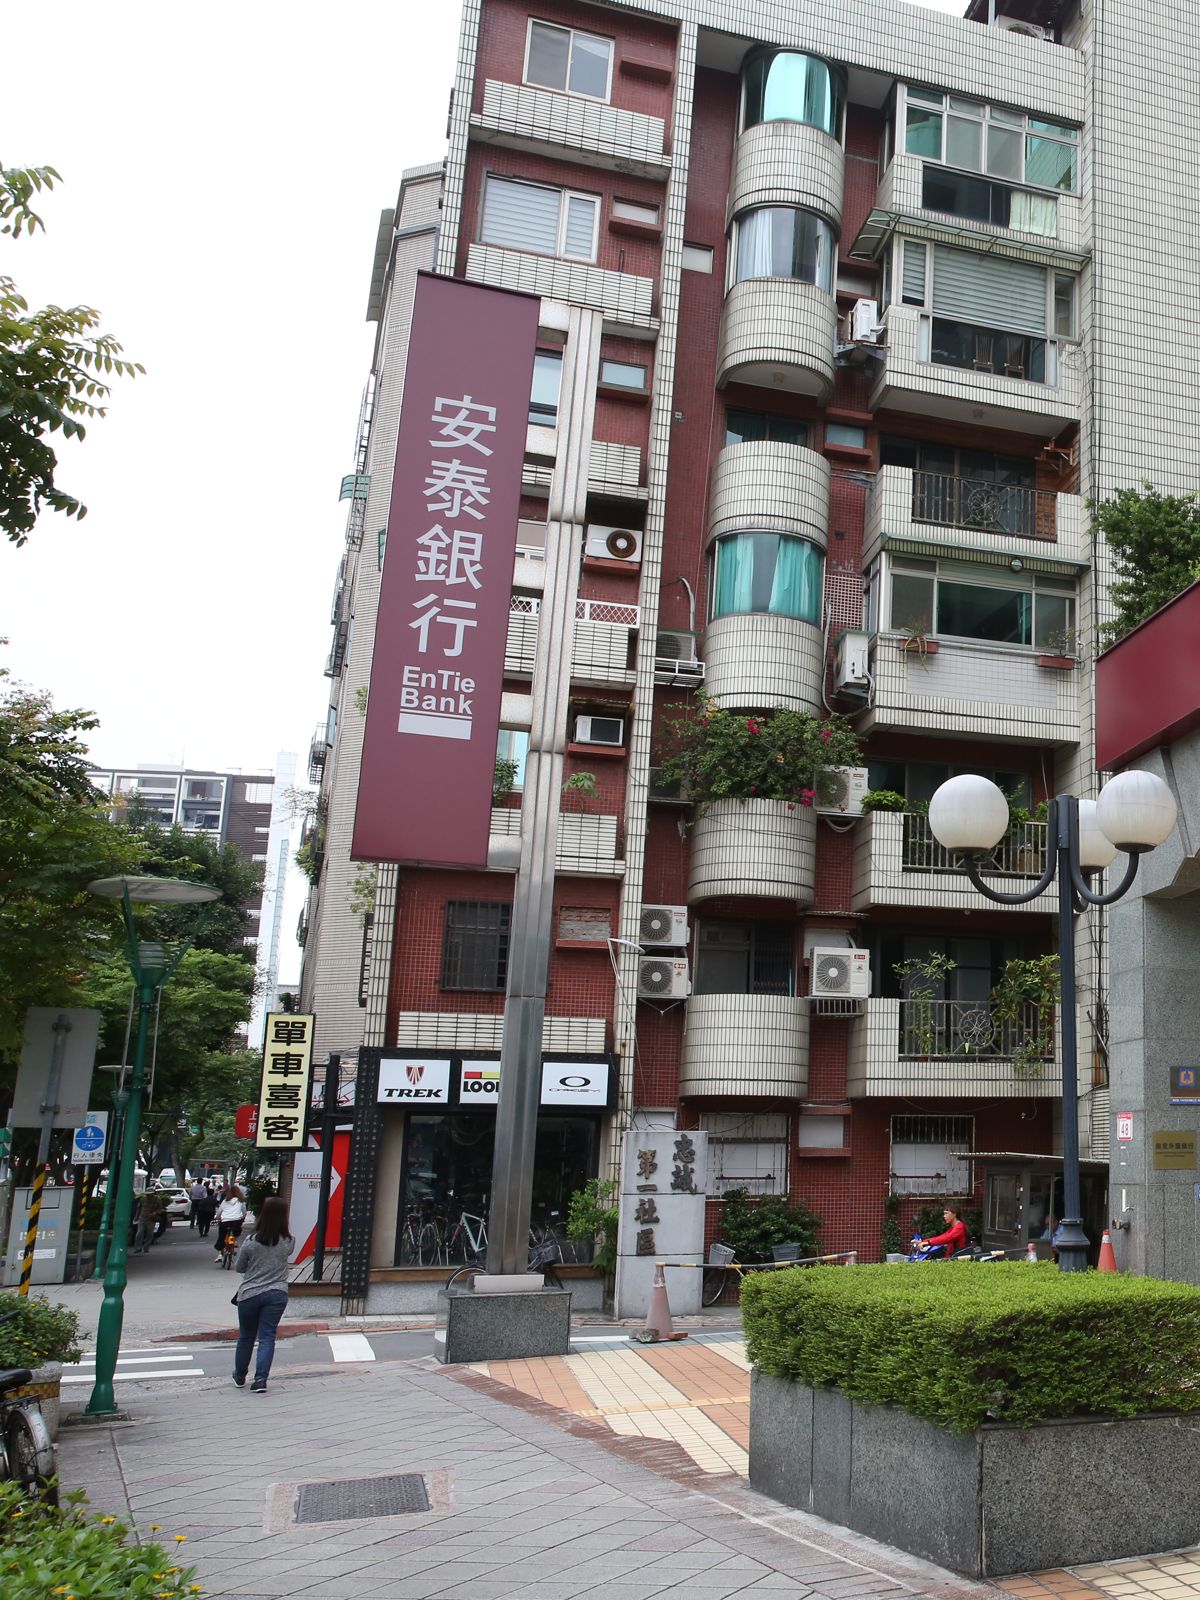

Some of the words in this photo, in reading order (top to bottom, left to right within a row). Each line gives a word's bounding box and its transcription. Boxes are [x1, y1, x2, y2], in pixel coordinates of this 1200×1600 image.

[409, 394, 497, 657] 安泰銀行
[400, 687, 473, 715] Bank
[402, 666, 476, 693] EnTie
[262, 1020, 306, 1140] 單車喜客
[384, 1088, 443, 1098] TREK
[671, 1133, 697, 1195] 忠誠
[635, 1149, 660, 1256] 第一社區
